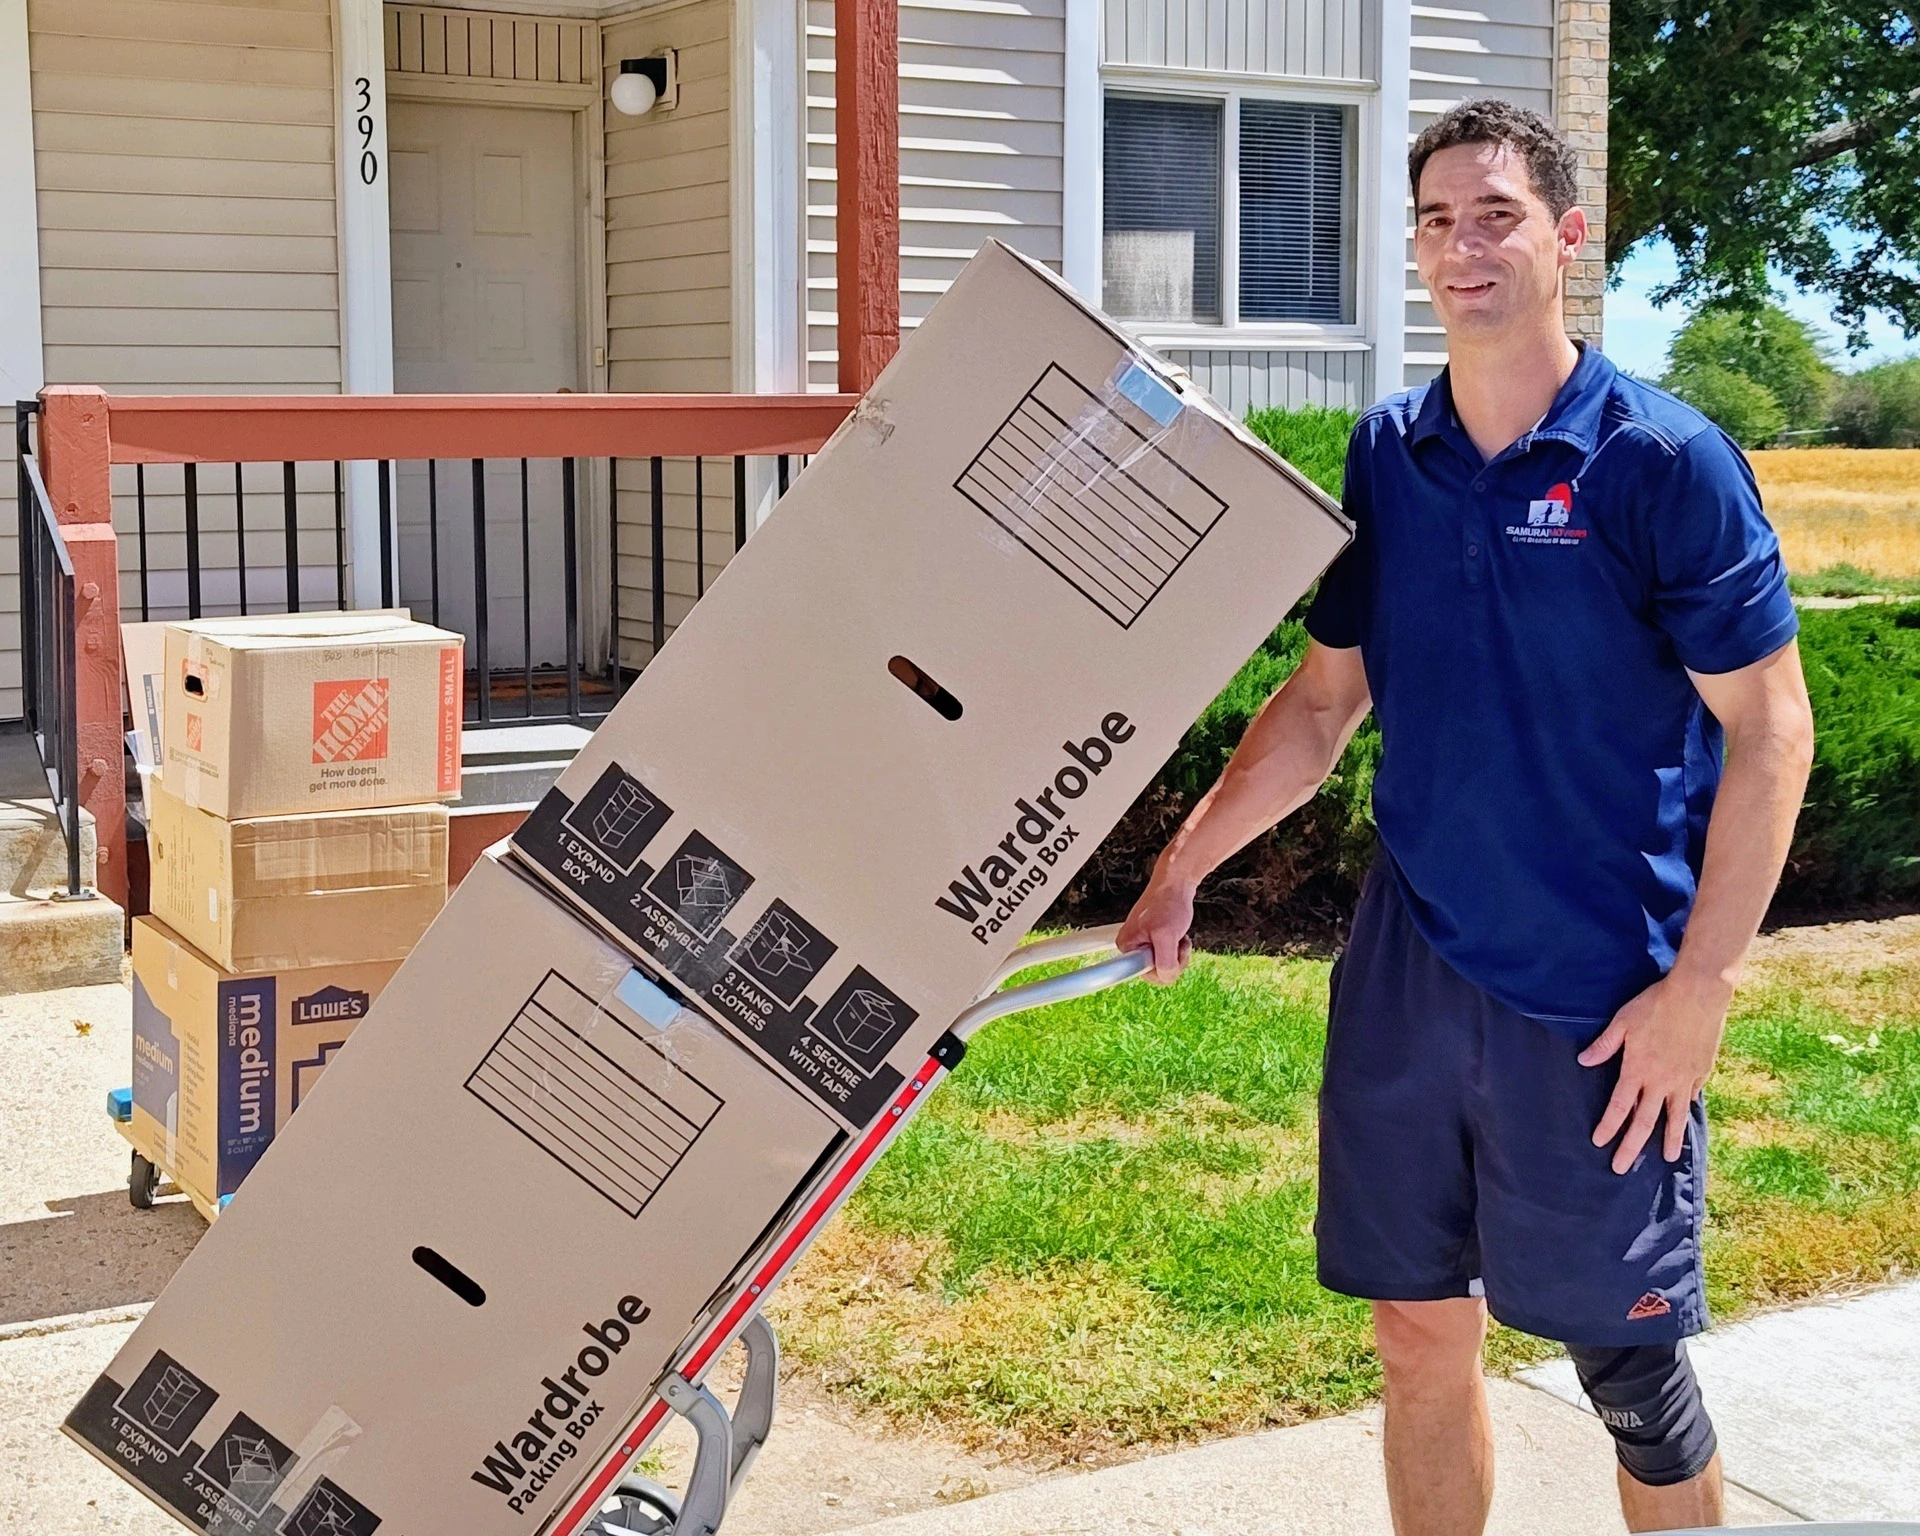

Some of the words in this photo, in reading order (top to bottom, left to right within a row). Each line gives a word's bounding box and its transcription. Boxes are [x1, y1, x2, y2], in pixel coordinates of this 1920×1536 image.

[355, 77, 378, 185] 390
[320, 688, 354, 722] THE
[445, 656, 455, 706] SMALL
[312, 679, 389, 763] HOME
[342, 708, 388, 761] DEPOT
[445, 711, 454, 740] DUTY
[309, 781, 327, 793] get
[329, 780, 357, 790] more
[359, 777, 388, 787] done.
[320, 768, 345, 778] How
[347, 766, 377, 777] doers
[444, 746, 453, 784] HEAVY
[934, 711, 1136, 924] Wardrobe
[557, 832, 567, 846] 1.
[566, 840, 616, 884] EXPAND
[561, 858, 592, 886] BOX
[971, 864, 1048, 945] Packing
[1036, 824, 1080, 867] Box
[629, 893, 642, 909] 2.
[641, 905, 706, 958] ASSEMBLE
[643, 926, 670, 952] BAR
[300, 997, 362, 1020] LOWE'S
[711, 983, 767, 1032] CLOTHES
[725, 972, 737, 986] 3.
[736, 981, 774, 1015] HANG
[228, 996, 239, 1047] mediana
[135, 1034, 174, 1075] medium
[240, 994, 270, 1133] medium
[788, 1045, 821, 1077] WITH
[819, 1072, 852, 1102] TAPE
[800, 1036, 812, 1049] 4.
[811, 1044, 862, 1089] SECURE
[470, 1295, 651, 1496] Wardrobe
[110, 1416, 119, 1430] 1.
[119, 1423, 168, 1464] EXPAND
[115, 1440, 145, 1467] BOX
[507, 1438, 577, 1515] Packing
[565, 1399, 605, 1440] Box
[182, 1472, 194, 1487] 2.
[194, 1482, 257, 1533] ASSEMBLE
[196, 1502, 223, 1527] BAR
